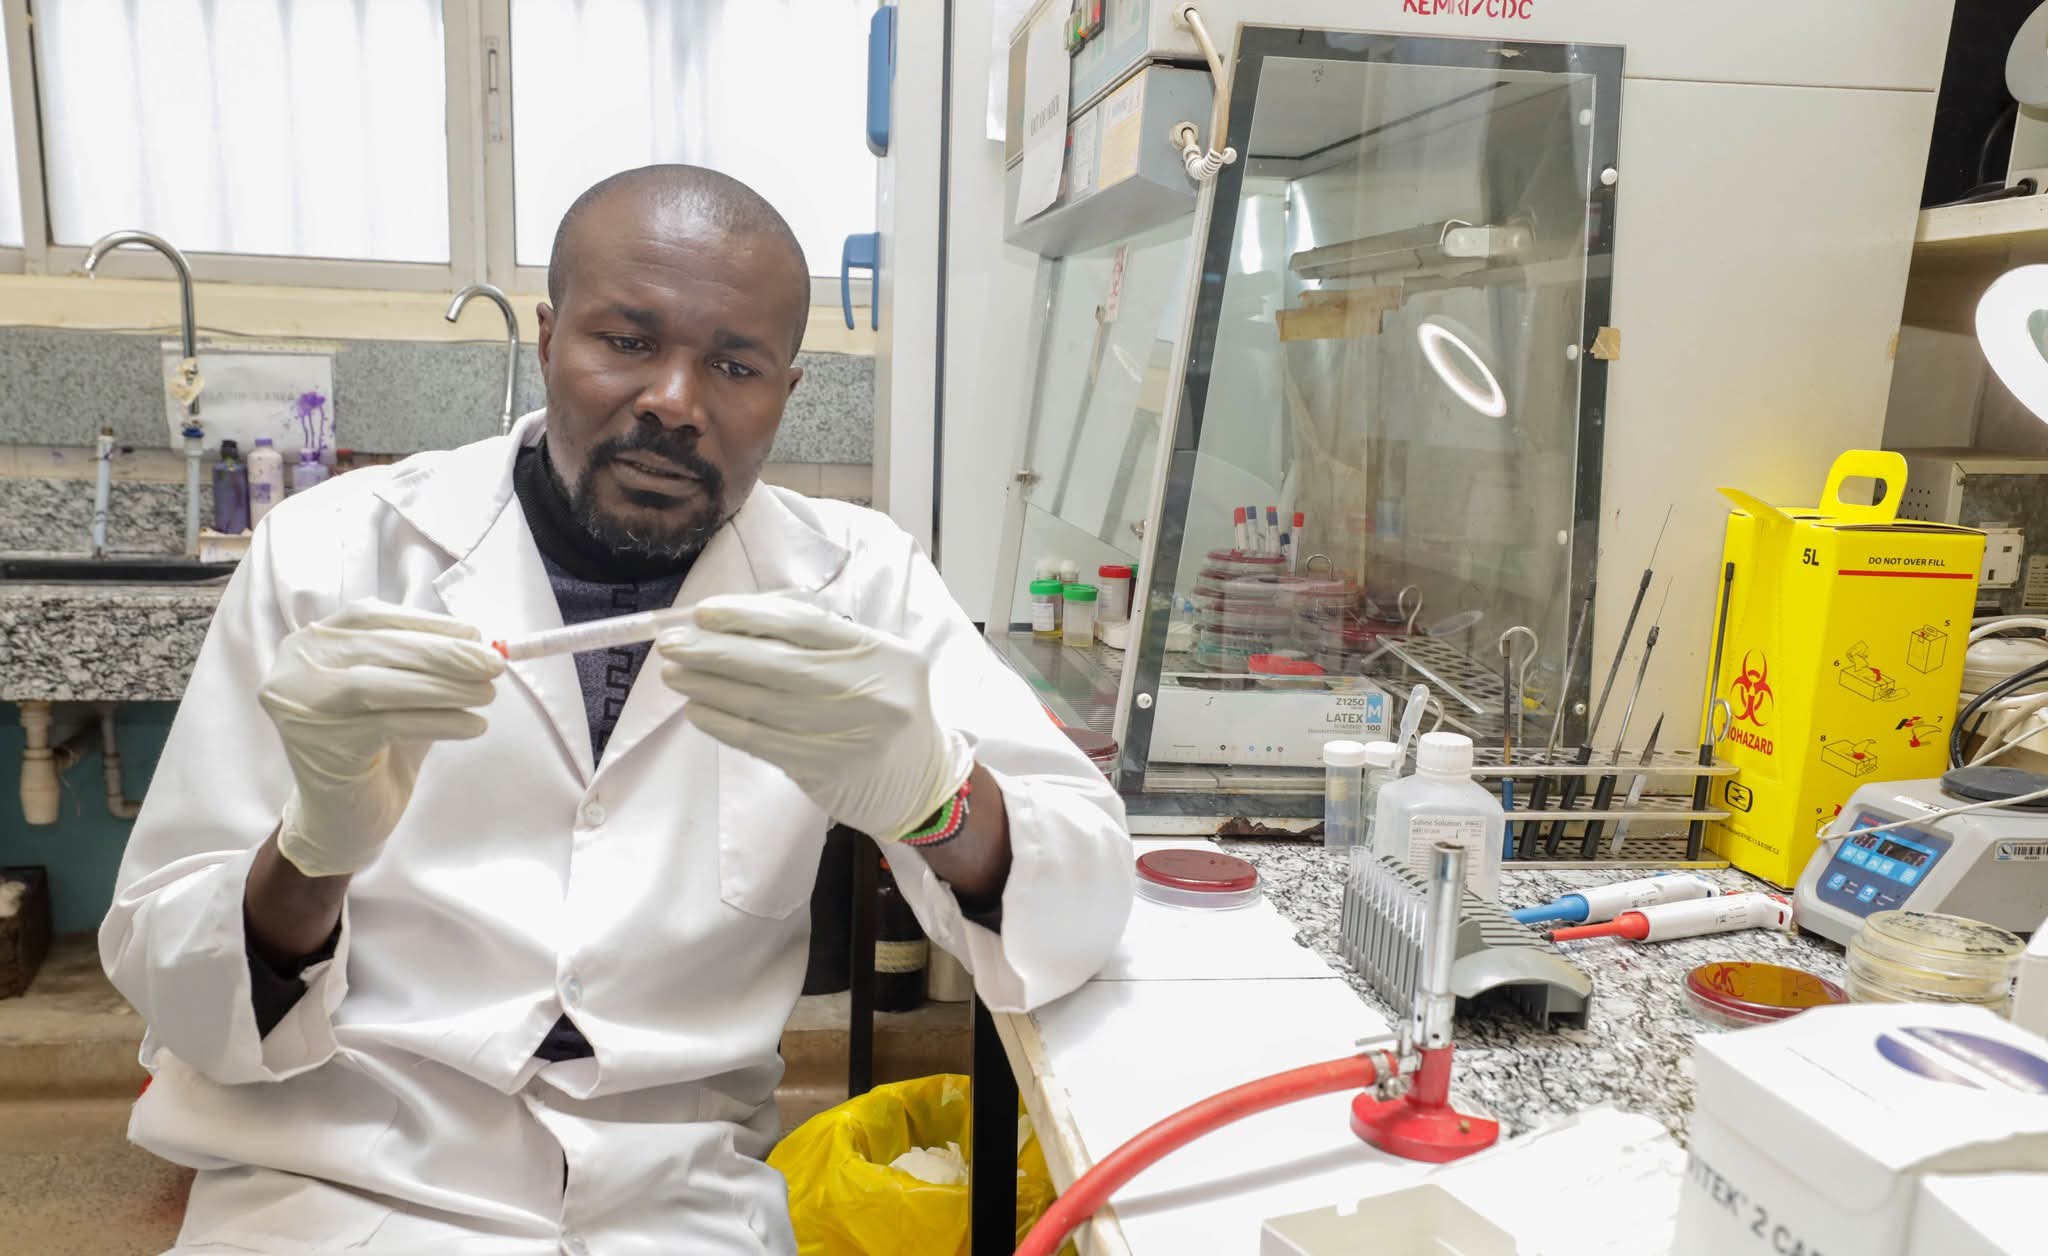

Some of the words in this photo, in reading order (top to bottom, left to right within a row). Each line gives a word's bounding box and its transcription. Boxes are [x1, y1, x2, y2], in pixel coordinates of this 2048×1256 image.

[1802, 548, 1819, 566] 5L
[1868, 557, 1882, 565] DO
[1883, 557, 1902, 565] NOT
[1903, 558, 1926, 566] OVER
[1928, 558, 1945, 567] FILL
[1326, 712, 1364, 723] LATEX
[1723, 722, 1774, 756] IOHAZARD
[1751, 1205, 1768, 1239] 2
[1771, 1225, 1824, 1256] CA
